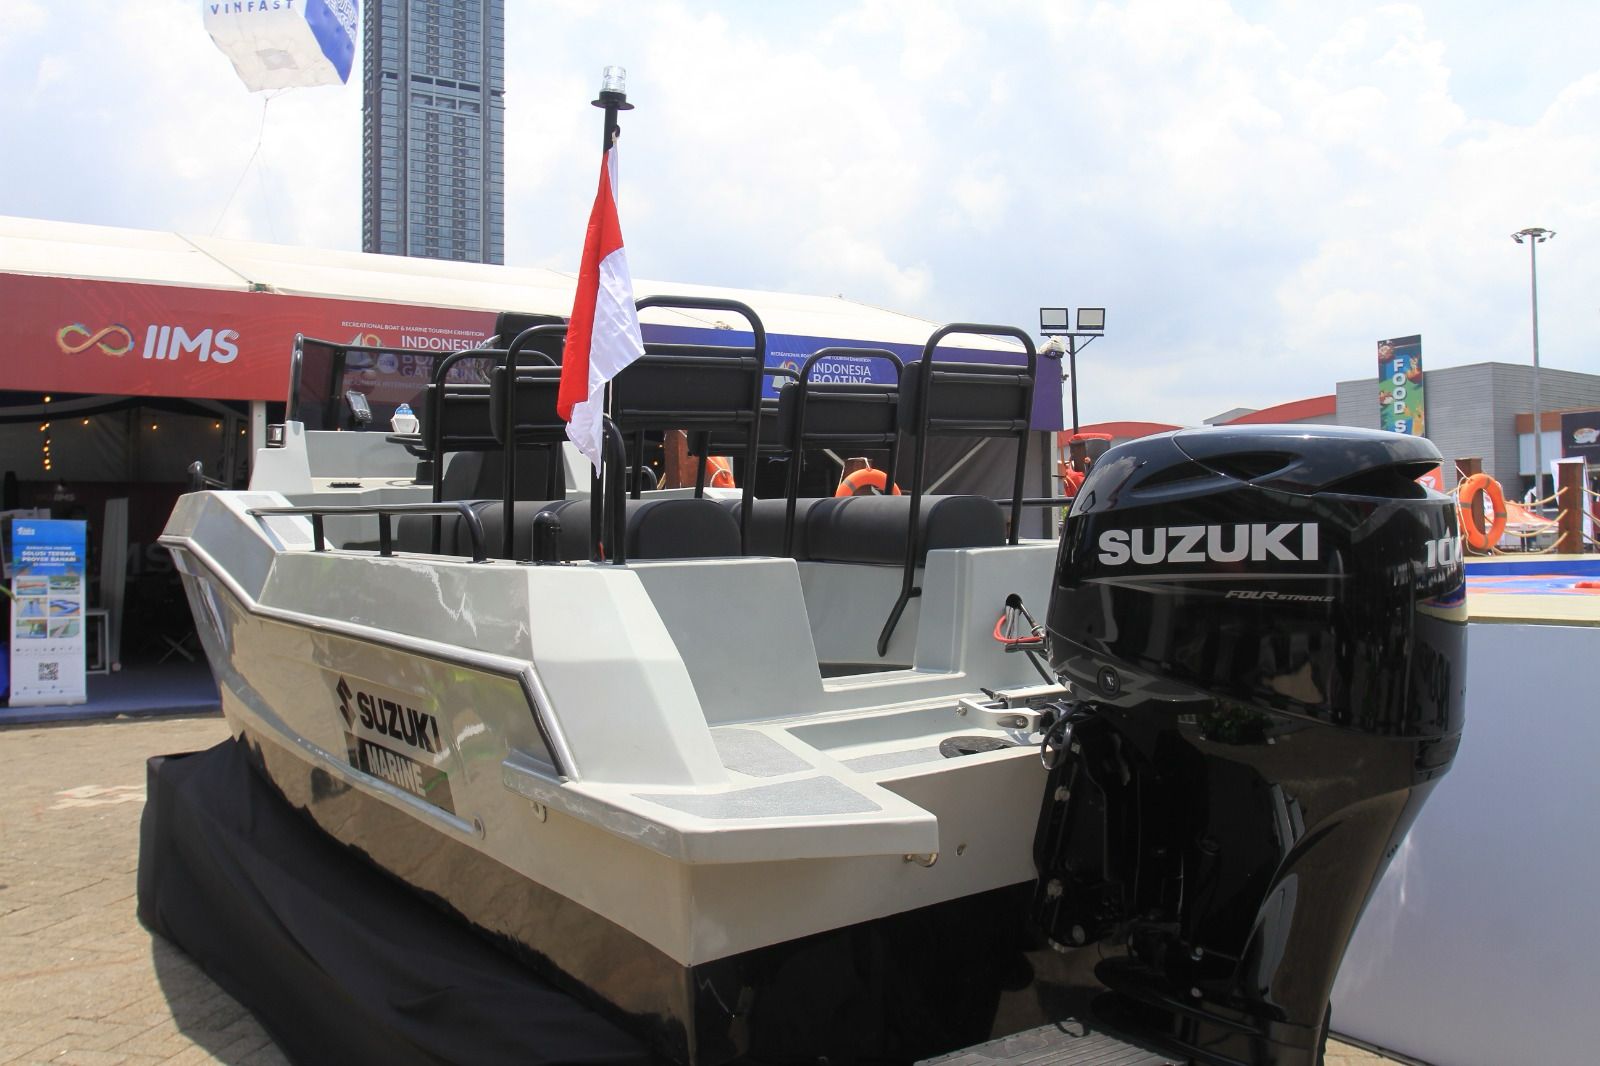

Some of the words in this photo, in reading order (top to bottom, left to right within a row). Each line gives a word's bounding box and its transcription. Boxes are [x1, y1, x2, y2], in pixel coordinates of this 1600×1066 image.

[210, 0, 294, 15] VINFAST
[142, 325, 240, 364] IIMS
[341, 321, 384, 330] RECREATIONAL
[813, 363, 872, 376] INDONESIA
[1097, 522, 1319, 566] SUZUKI
[356, 691, 443, 754] SUZUKI
[364, 743, 427, 797] MARINE
